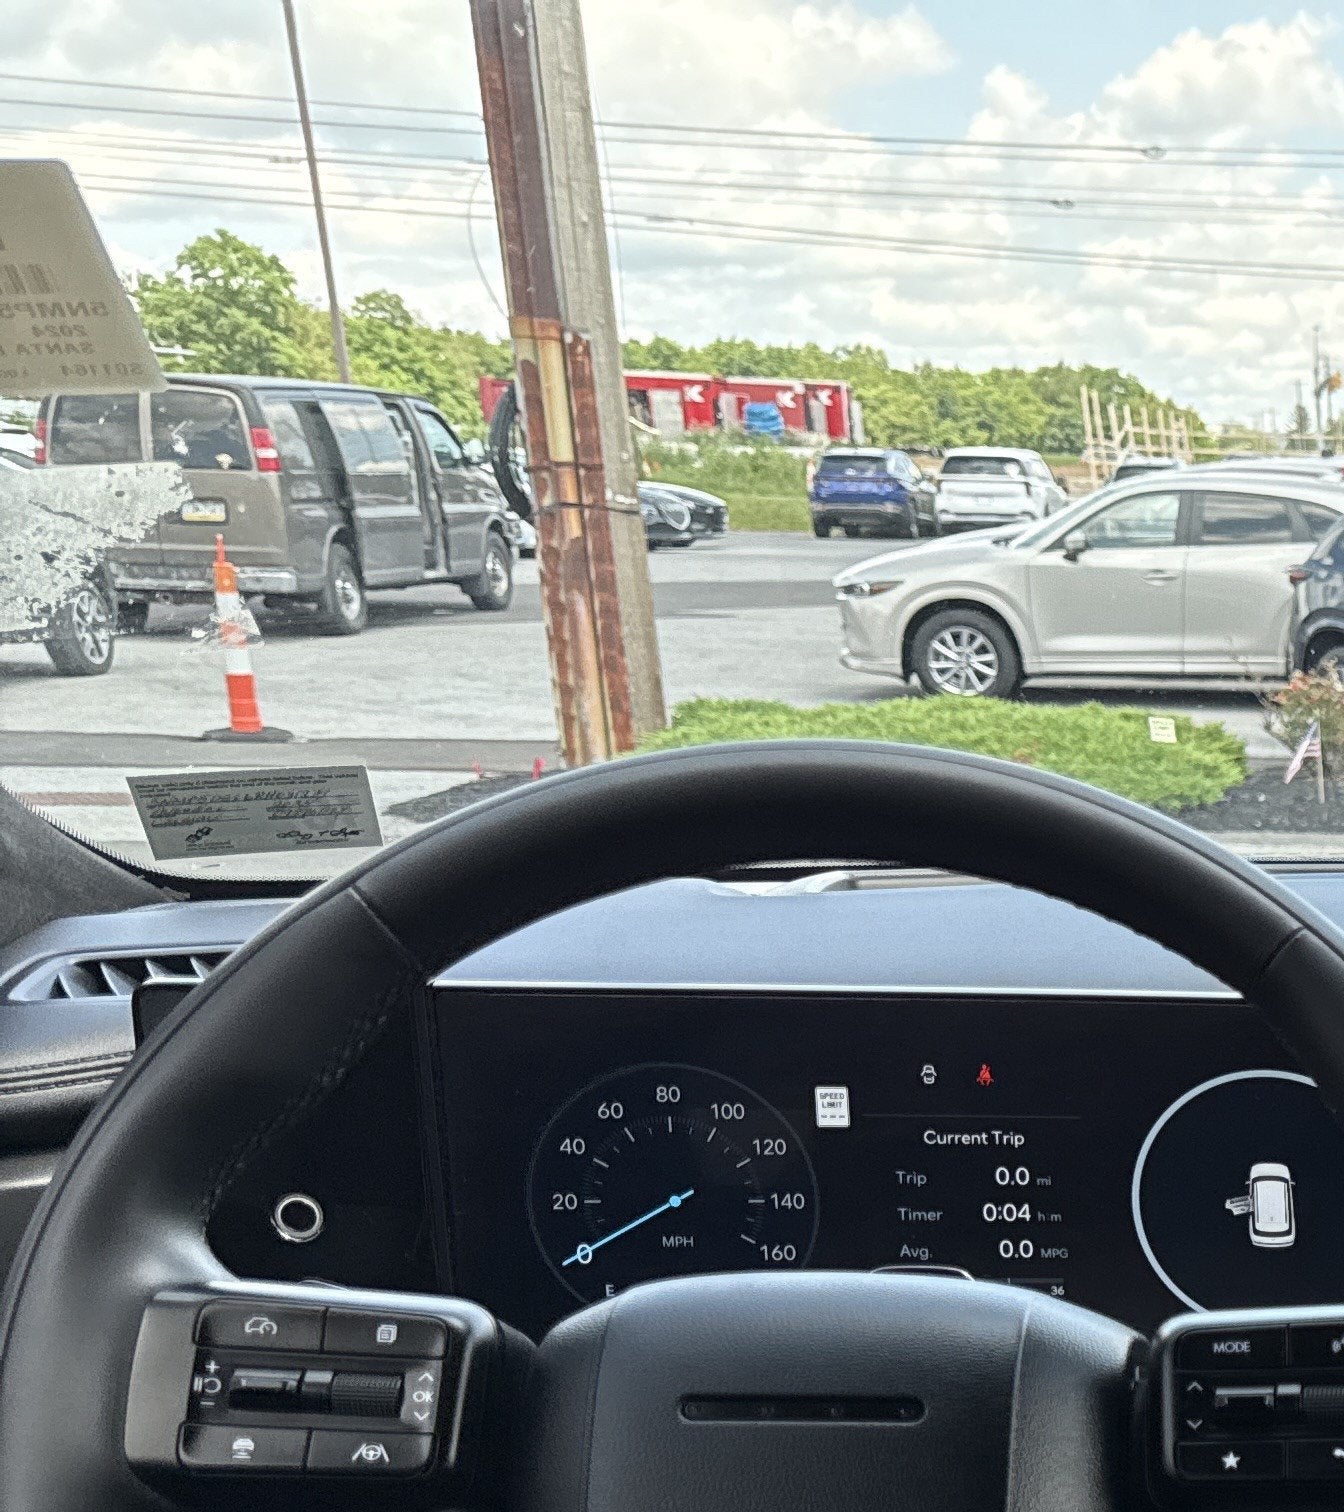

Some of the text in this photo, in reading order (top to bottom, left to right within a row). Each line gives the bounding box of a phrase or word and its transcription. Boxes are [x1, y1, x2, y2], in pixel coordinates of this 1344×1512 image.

[656, 1086, 681, 1103] 80
[819, 1092, 845, 1100] SPEED
[597, 1102, 624, 1119] 60
[710, 1104, 745, 1120] 100
[559, 1138, 586, 1155] 40
[752, 1139, 787, 1156] 120
[923, 1130, 1025, 1148] Current Trip
[895, 1167, 1052, 1187] Trip 0.0 mi
[552, 1193, 578, 1210] 20
[770, 1193, 805, 1210] 140
[897, 1203, 1031, 1222] Timer 0:04
[662, 1236, 694, 1247] MPH
[900, 1239, 1068, 1260] Avg. 0.0 MPG
[576, 1243, 593, 1264] 0
[759, 1245, 797, 1261] 160
[605, 1284, 615, 1297] E
[1050, 1285, 1065, 1296] 36
[1213, 1341, 1251, 1353] MODE
[412, 1389, 434, 1403] OK
